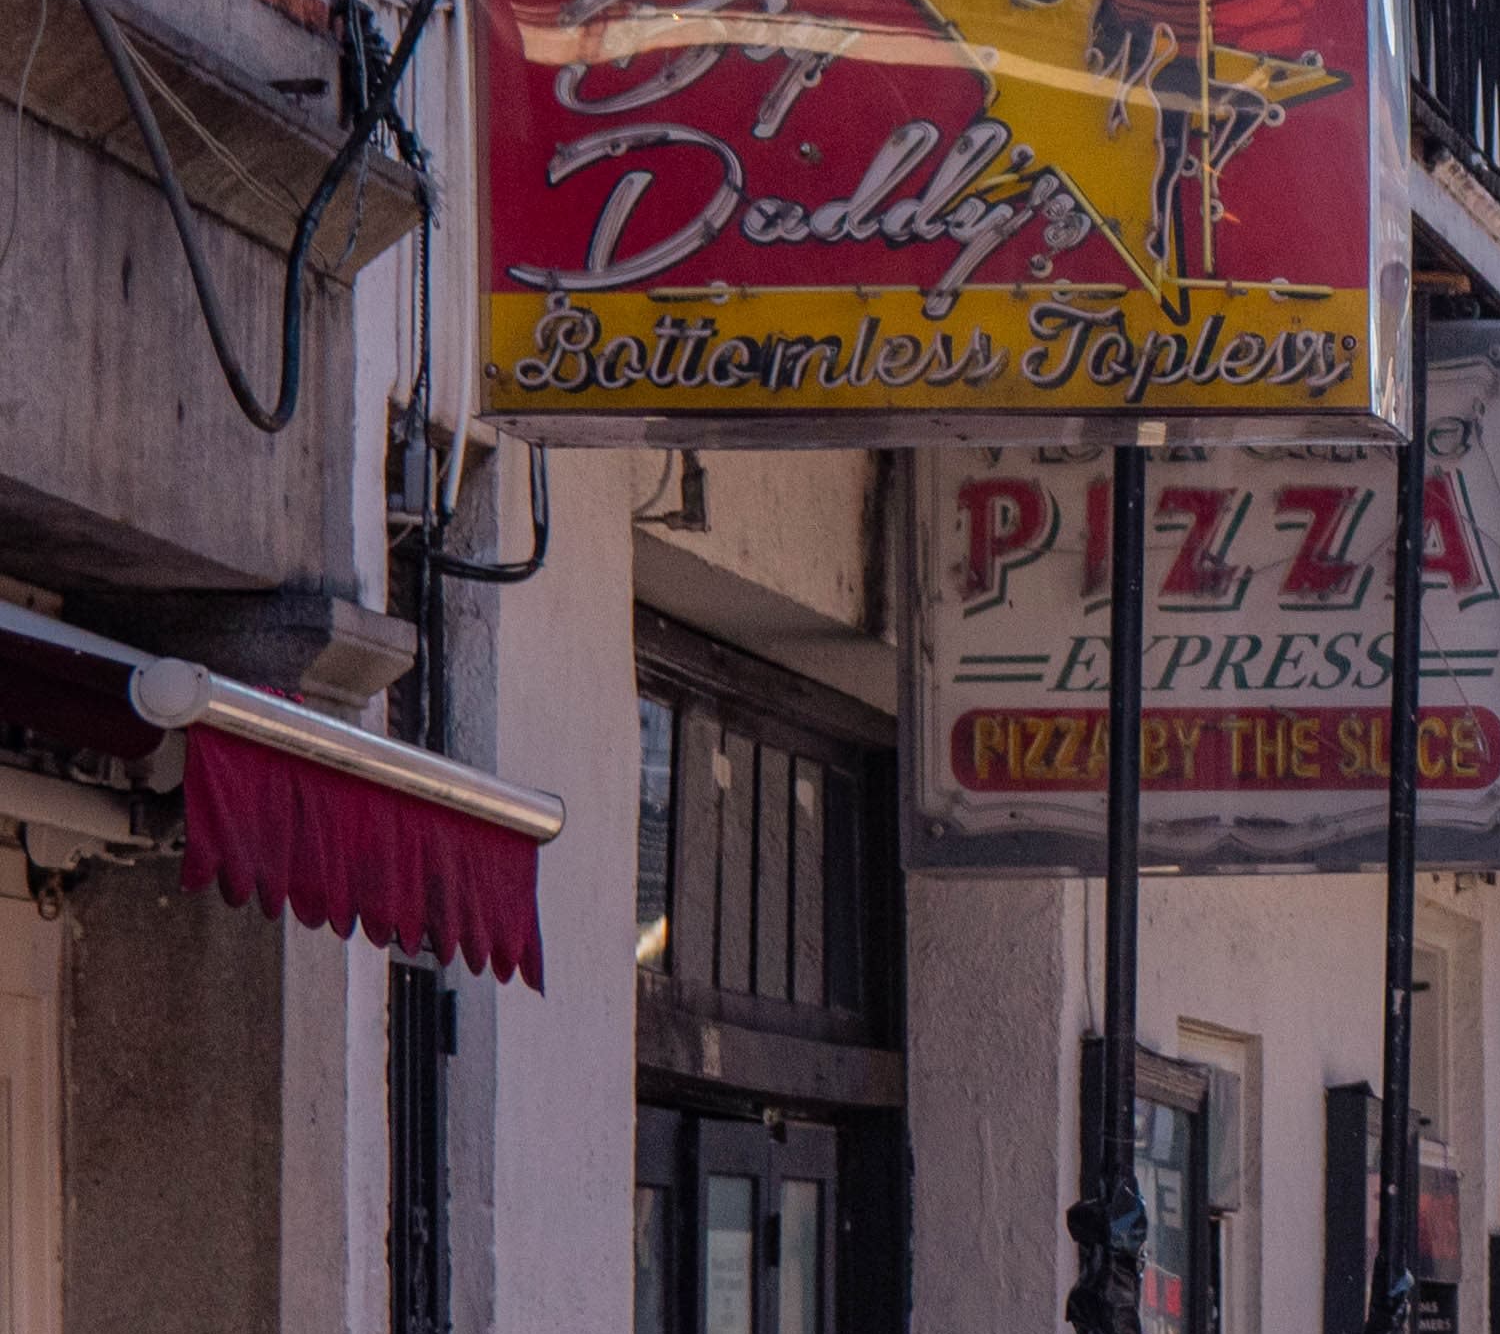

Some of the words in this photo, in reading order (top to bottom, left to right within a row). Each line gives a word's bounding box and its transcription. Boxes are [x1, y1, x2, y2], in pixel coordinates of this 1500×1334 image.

[506, 118, 1092, 320] Daddy's
[513, 305, 1008, 390] Bottomless
[1021, 301, 1354, 404] Topless
[956, 469, 1500, 618] PIZZA
[972, 715, 1111, 781] PIZZA
[1141, 719, 1203, 779] BY
[1216, 717, 1321, 779] THE
[1336, 717, 1484, 779] SLCE
